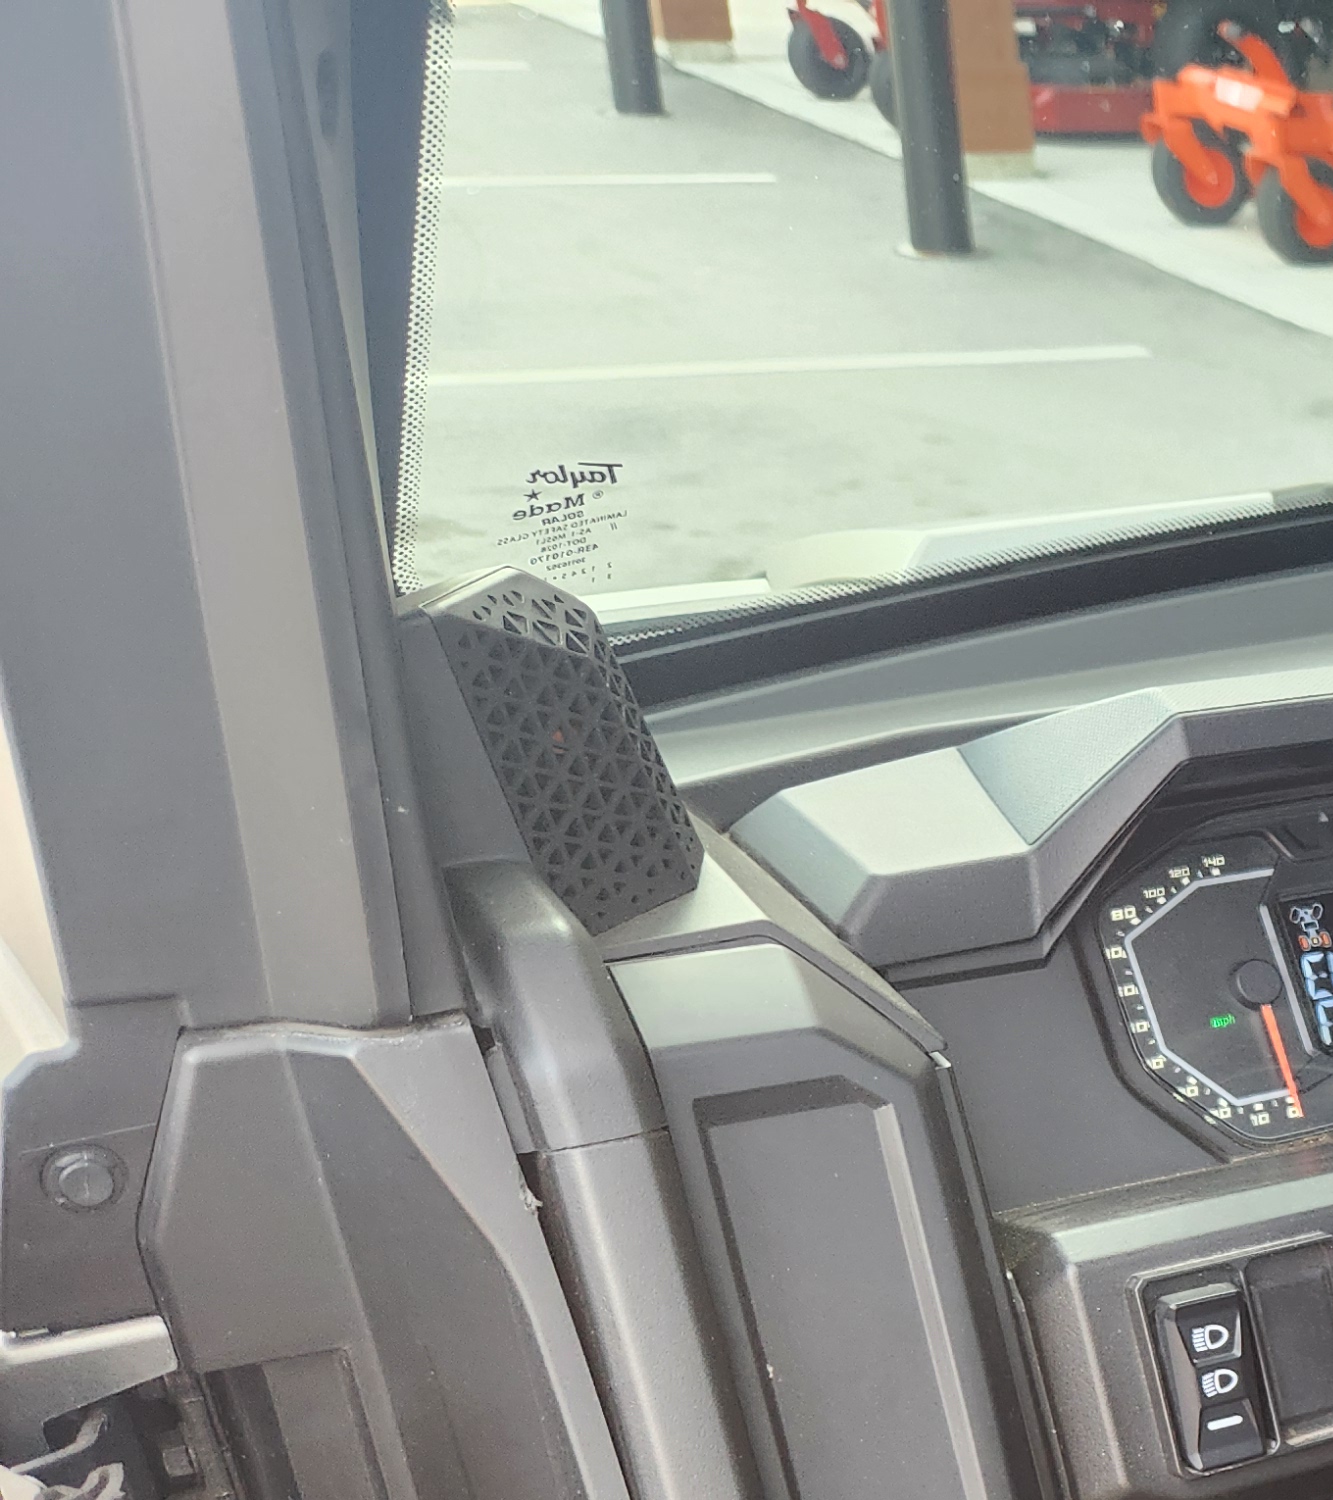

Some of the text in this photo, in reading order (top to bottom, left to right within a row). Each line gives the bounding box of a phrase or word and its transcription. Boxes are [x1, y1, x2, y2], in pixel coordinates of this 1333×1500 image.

[1202, 856, 1225, 867] 140
[1168, 867, 1190, 878] 120
[1143, 888, 1165, 898] 100
[1110, 906, 1136, 921] 80
[1210, 1014, 1236, 1028] mph
